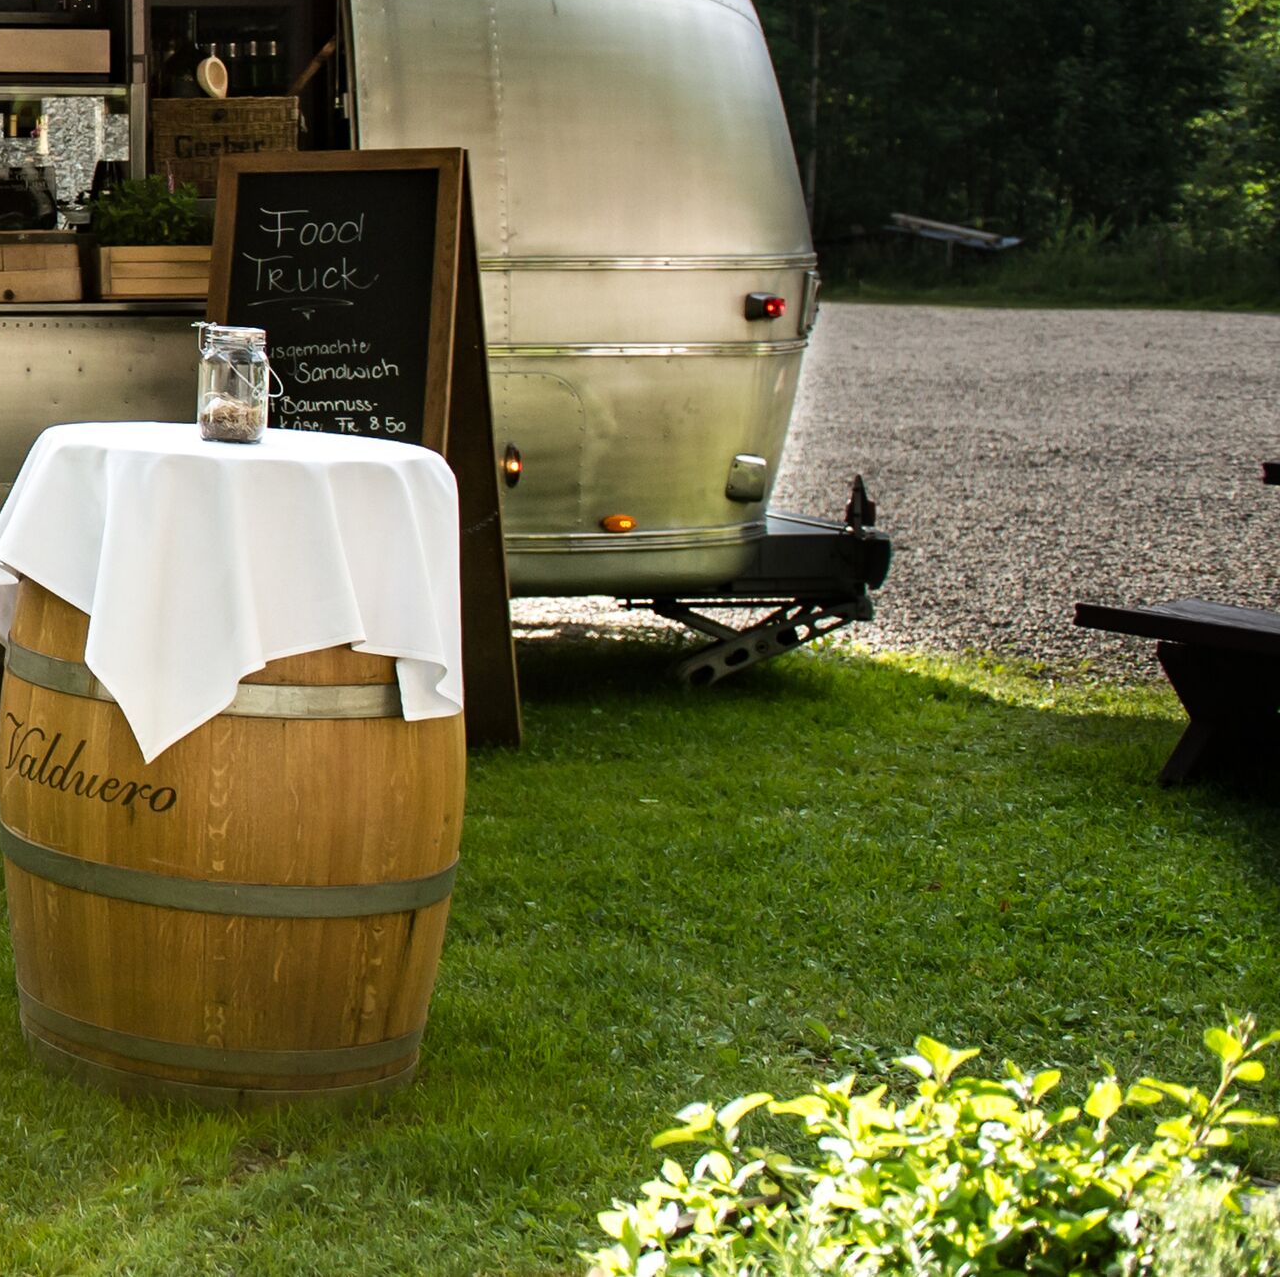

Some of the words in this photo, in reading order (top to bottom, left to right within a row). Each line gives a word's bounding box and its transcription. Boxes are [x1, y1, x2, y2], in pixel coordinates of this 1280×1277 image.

[259, 207, 365, 248] Food
[295, 358, 400, 384] Sandwich
[5, 711, 178, 813] Valduero
